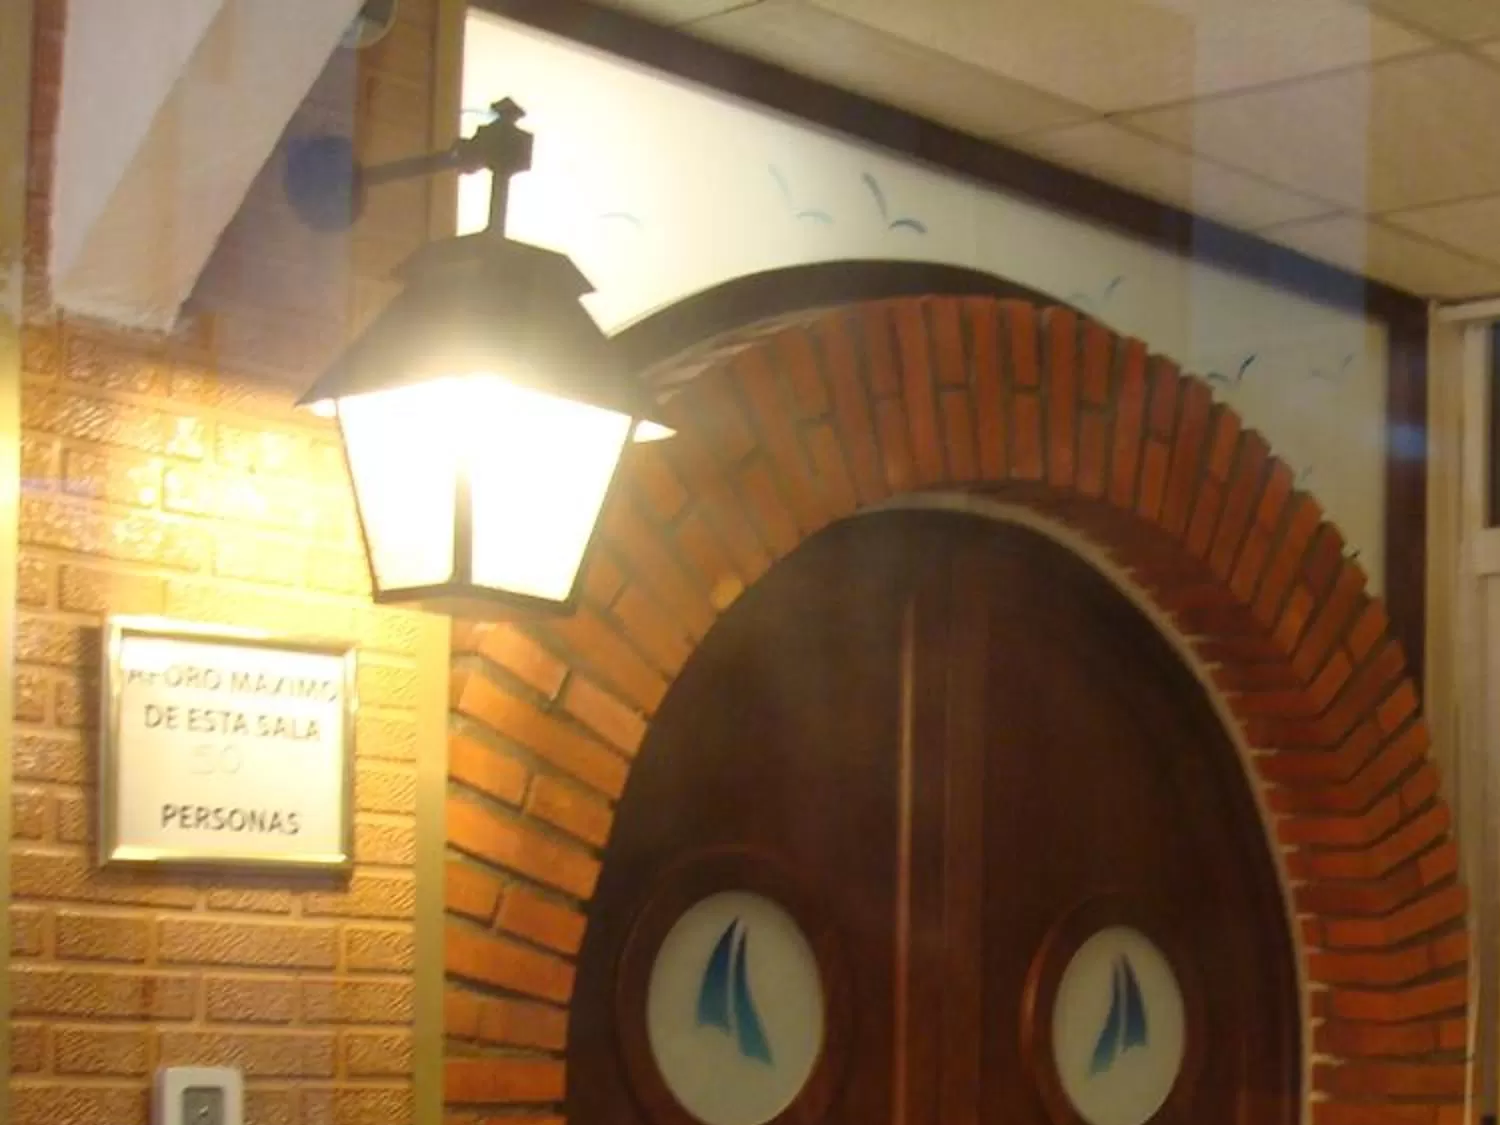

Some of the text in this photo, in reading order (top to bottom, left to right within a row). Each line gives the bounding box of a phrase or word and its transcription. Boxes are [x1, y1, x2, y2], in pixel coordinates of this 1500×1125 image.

[143, 704, 321, 741] DE ESTA SALA
[161, 803, 302, 836] PERSONAS
